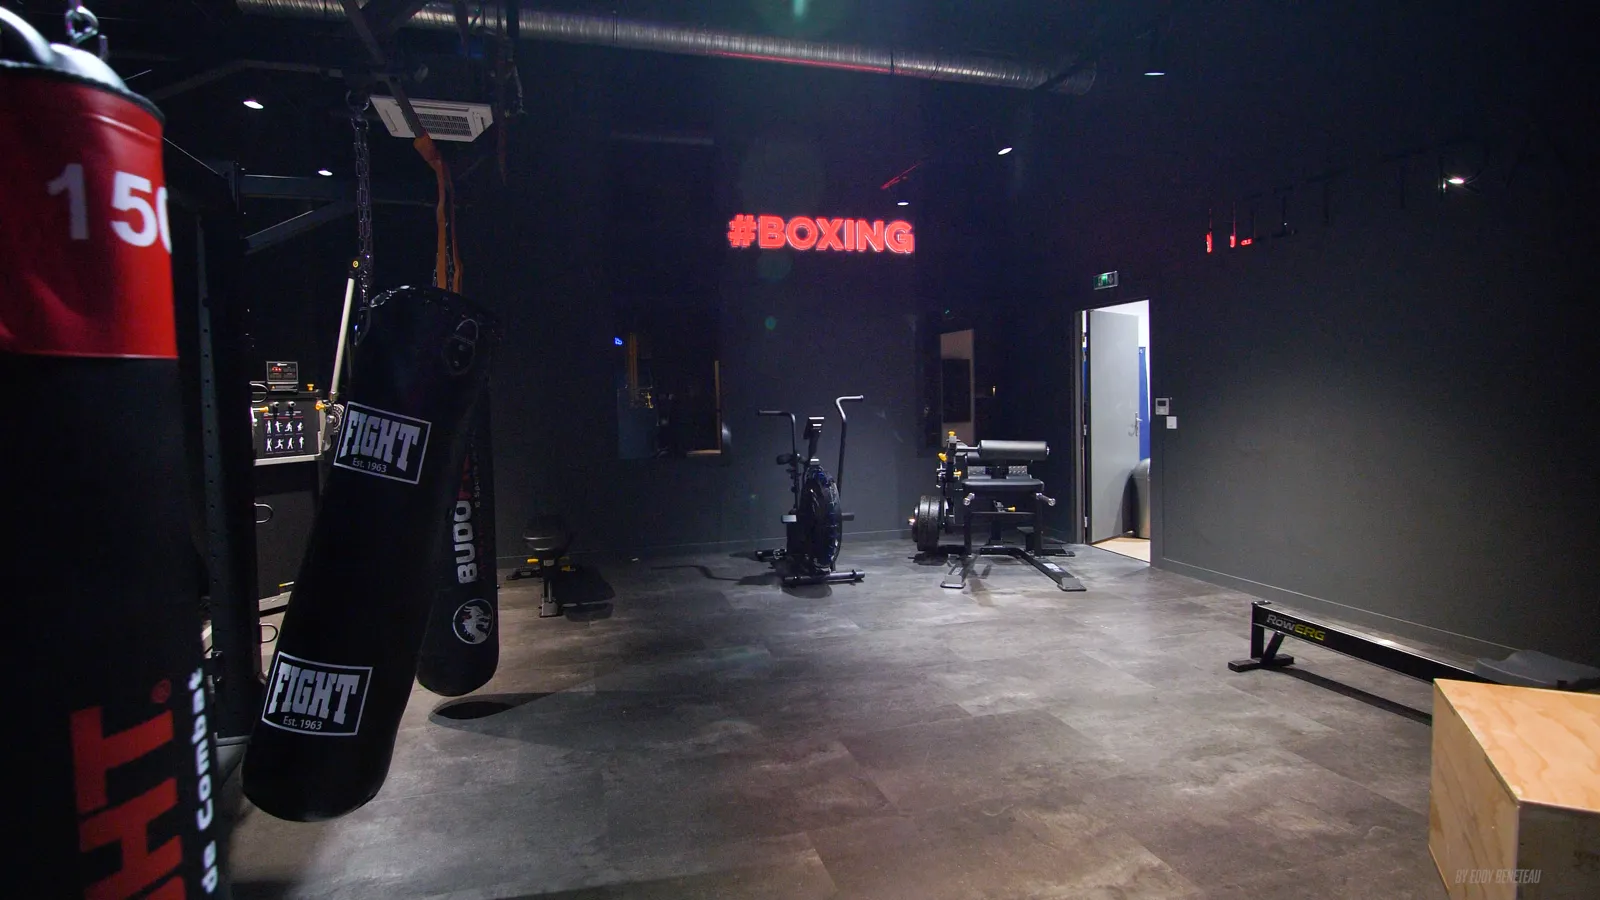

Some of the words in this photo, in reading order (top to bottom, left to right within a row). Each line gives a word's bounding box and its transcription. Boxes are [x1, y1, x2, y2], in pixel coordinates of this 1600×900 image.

[727, 213, 915, 253] #BOXING
[340, 410, 421, 472] FIGHT
[352, 458, 365, 468] Est.
[367, 461, 388, 473] 1963
[267, 661, 361, 725] FIGHT
[188, 667, 214, 831] Combat
[283, 716, 298, 727] Est.
[300, 719, 323, 731] 1963
